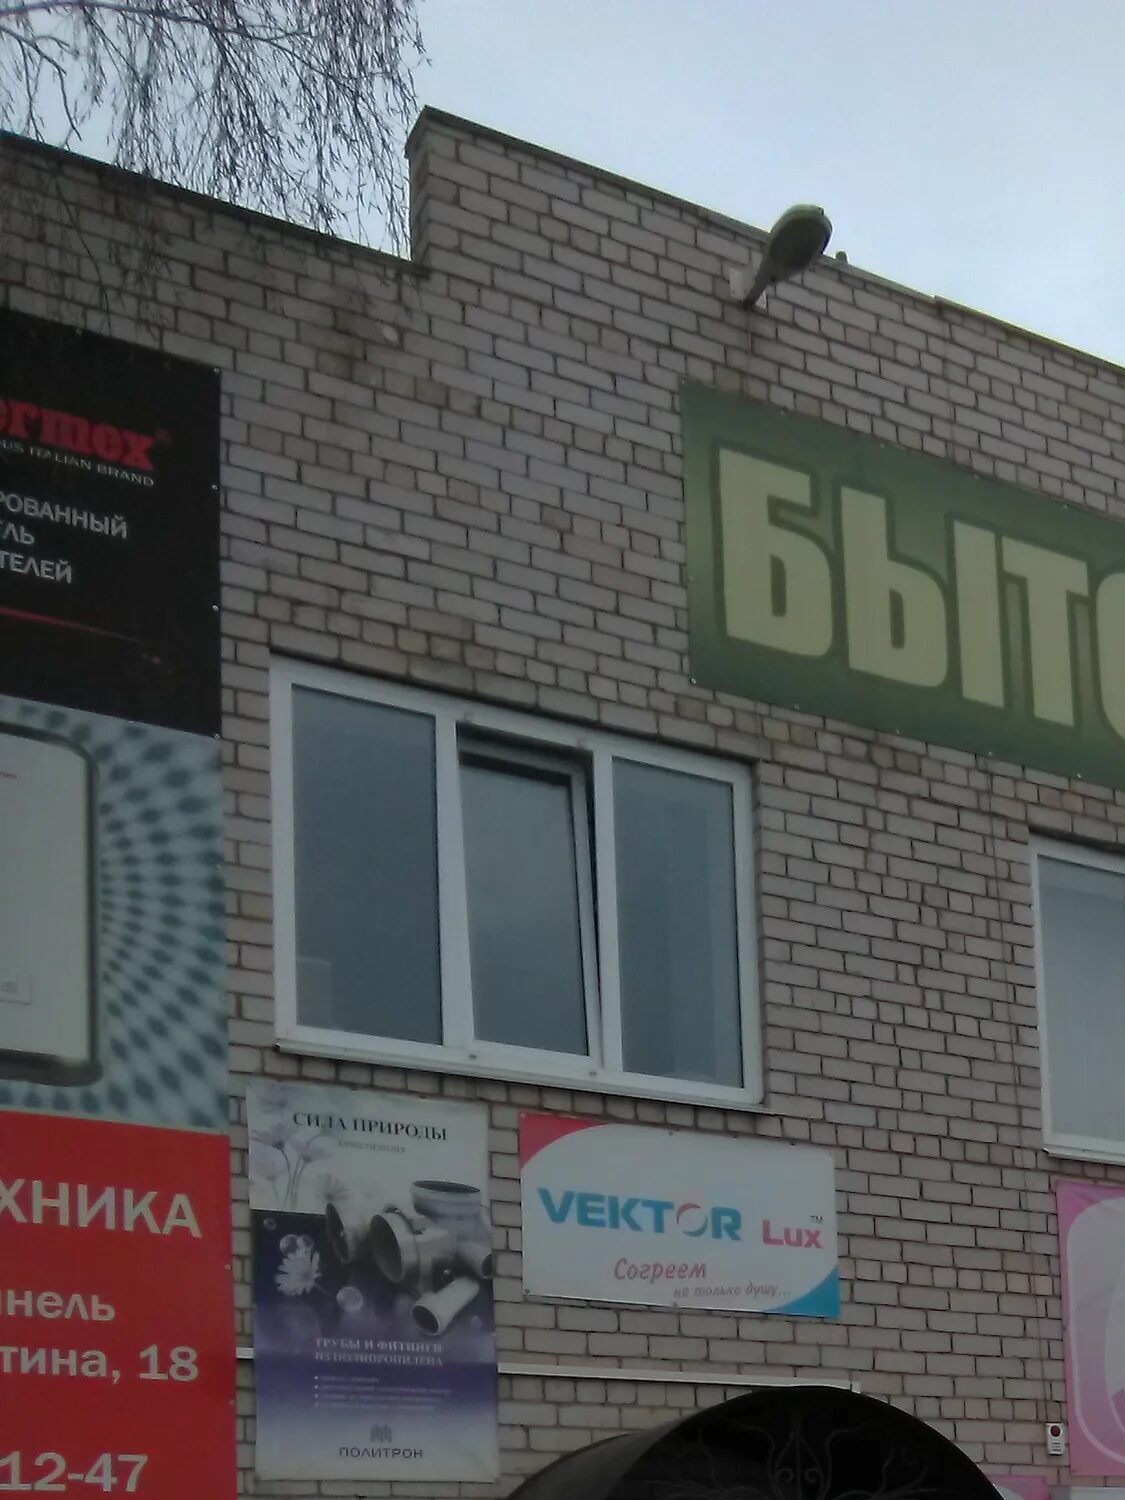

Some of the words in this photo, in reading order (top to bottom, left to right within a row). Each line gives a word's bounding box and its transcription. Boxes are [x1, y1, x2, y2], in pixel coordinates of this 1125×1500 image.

[0, 399, 154, 472] rmex
[30, 446, 92, 470] ITALIAN
[97, 468, 154, 487] BRAND
[0, 521, 36, 546] ЛЬ
[293, 1112, 347, 1131] СИЛА
[352, 1118, 447, 1141] ПРИРОДЫ
[537, 1187, 743, 1241] VEKTOR
[761, 1219, 824, 1249] Lux
[613, 1258, 706, 1283] Согреем
[0, 1290, 116, 1322] нель
[673, 1288, 689, 1299] не
[693, 1286, 741, 1299] только
[315, 1338, 360, 1349] ТРУБЫ
[138, 1345, 199, 1382] 18
[339, 1447, 424, 1459] ПОЛИТРОН
